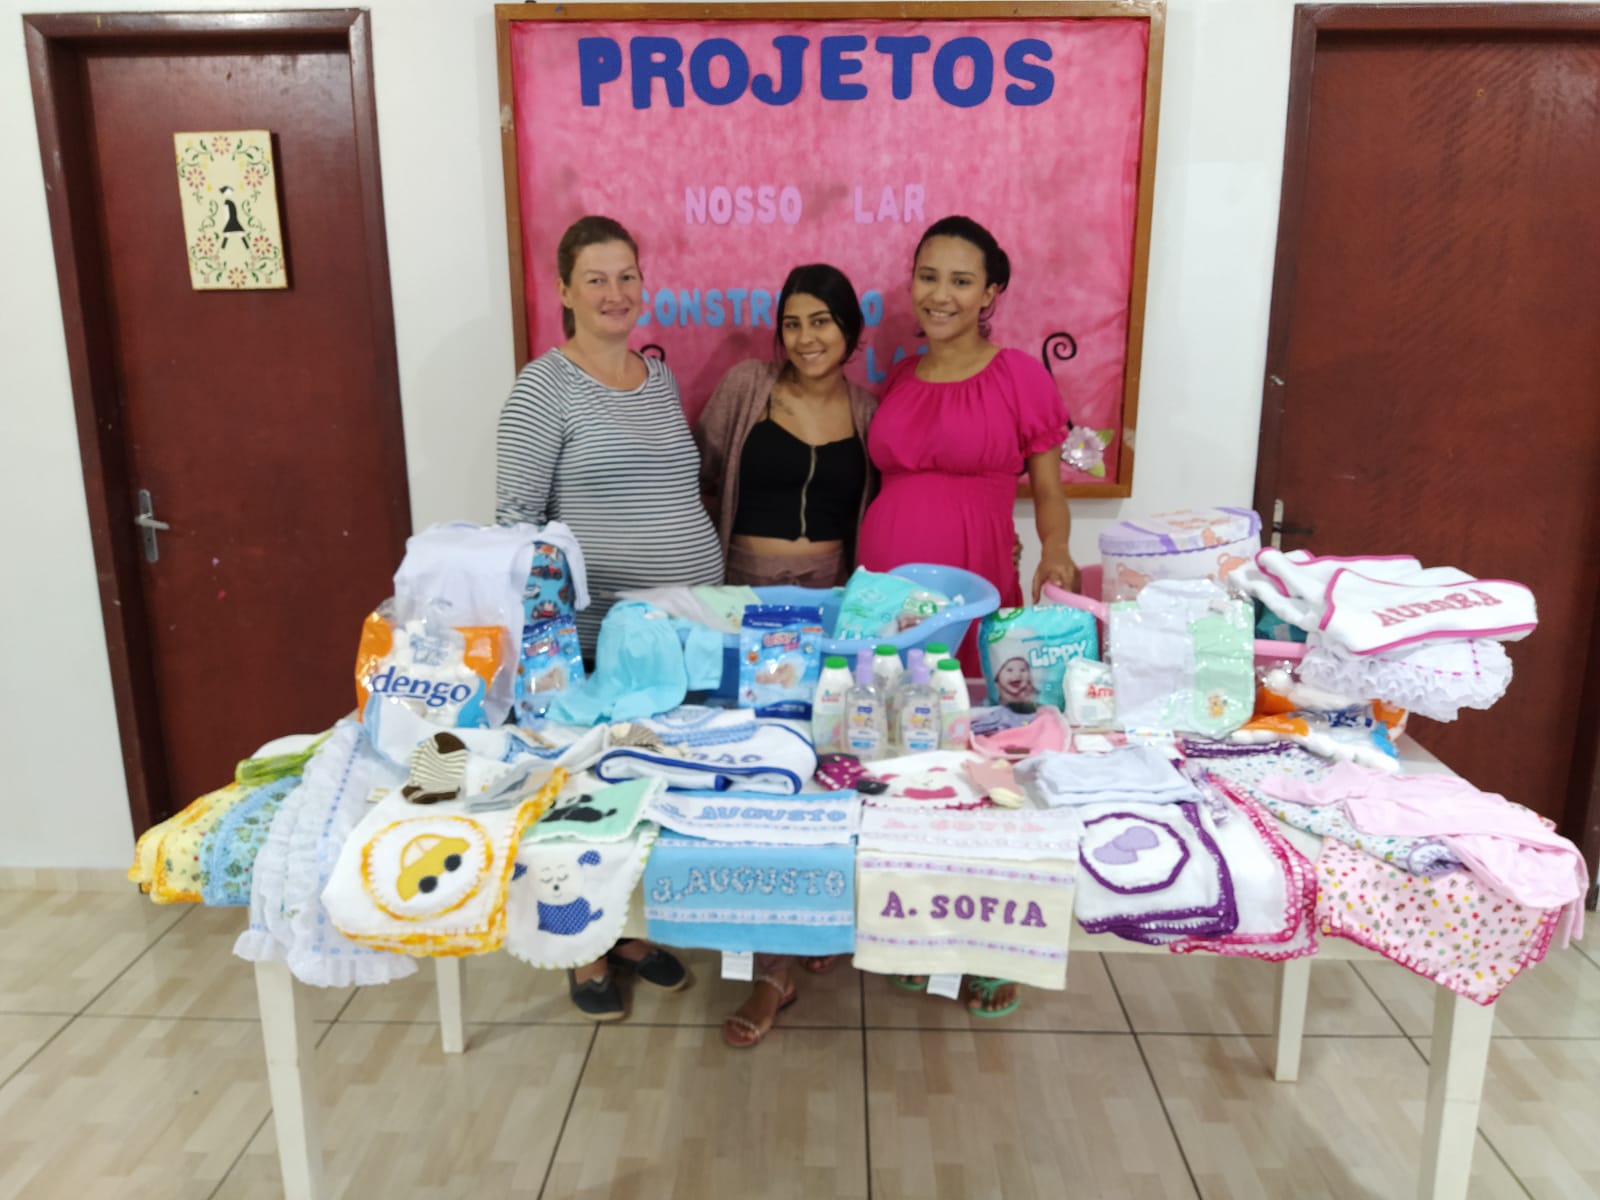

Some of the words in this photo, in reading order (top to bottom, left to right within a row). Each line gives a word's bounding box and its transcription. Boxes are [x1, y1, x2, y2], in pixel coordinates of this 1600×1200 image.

[578, 35, 1055, 109] PROJETOS
[685, 185, 802, 224] NOSSO
[854, 184, 925, 223] LAR
[372, 665, 472, 707] dengo
[695, 805, 847, 823] AUGUSTO
[930, 894, 1047, 928] SOFIA
